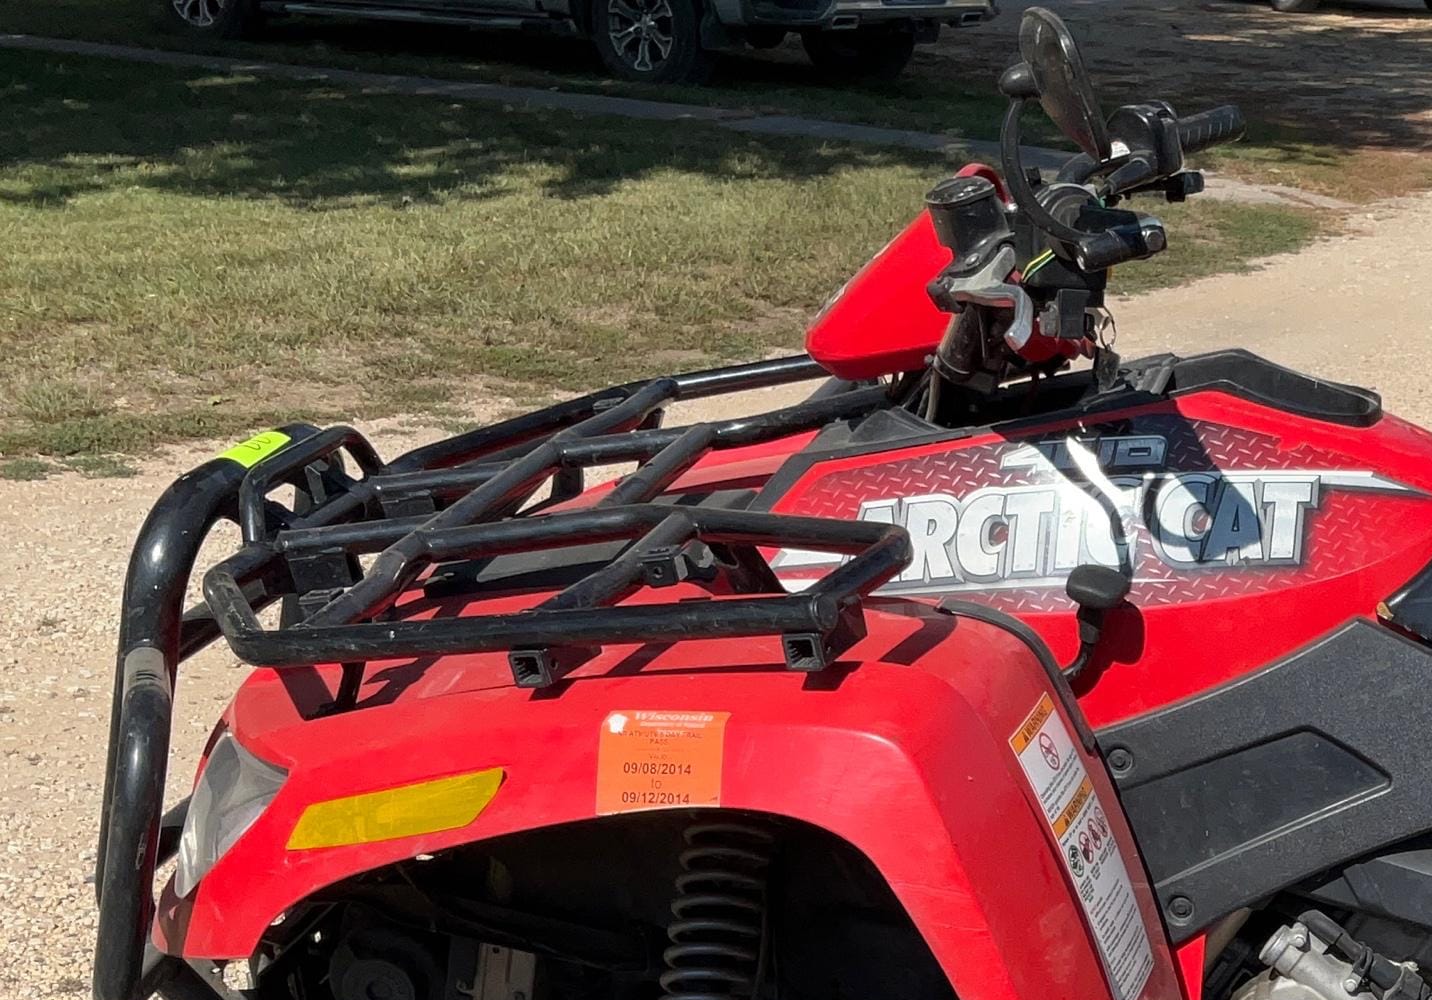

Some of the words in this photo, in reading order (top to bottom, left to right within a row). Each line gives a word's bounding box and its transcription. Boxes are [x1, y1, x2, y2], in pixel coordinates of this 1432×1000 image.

[1143, 473, 1323, 570] CAT
[634, 711, 714, 722] Wisconsin
[1023, 703, 1048, 739] WARNING
[623, 762, 692, 775] 09/08/2014
[621, 791, 690, 805] 09/12/2014
